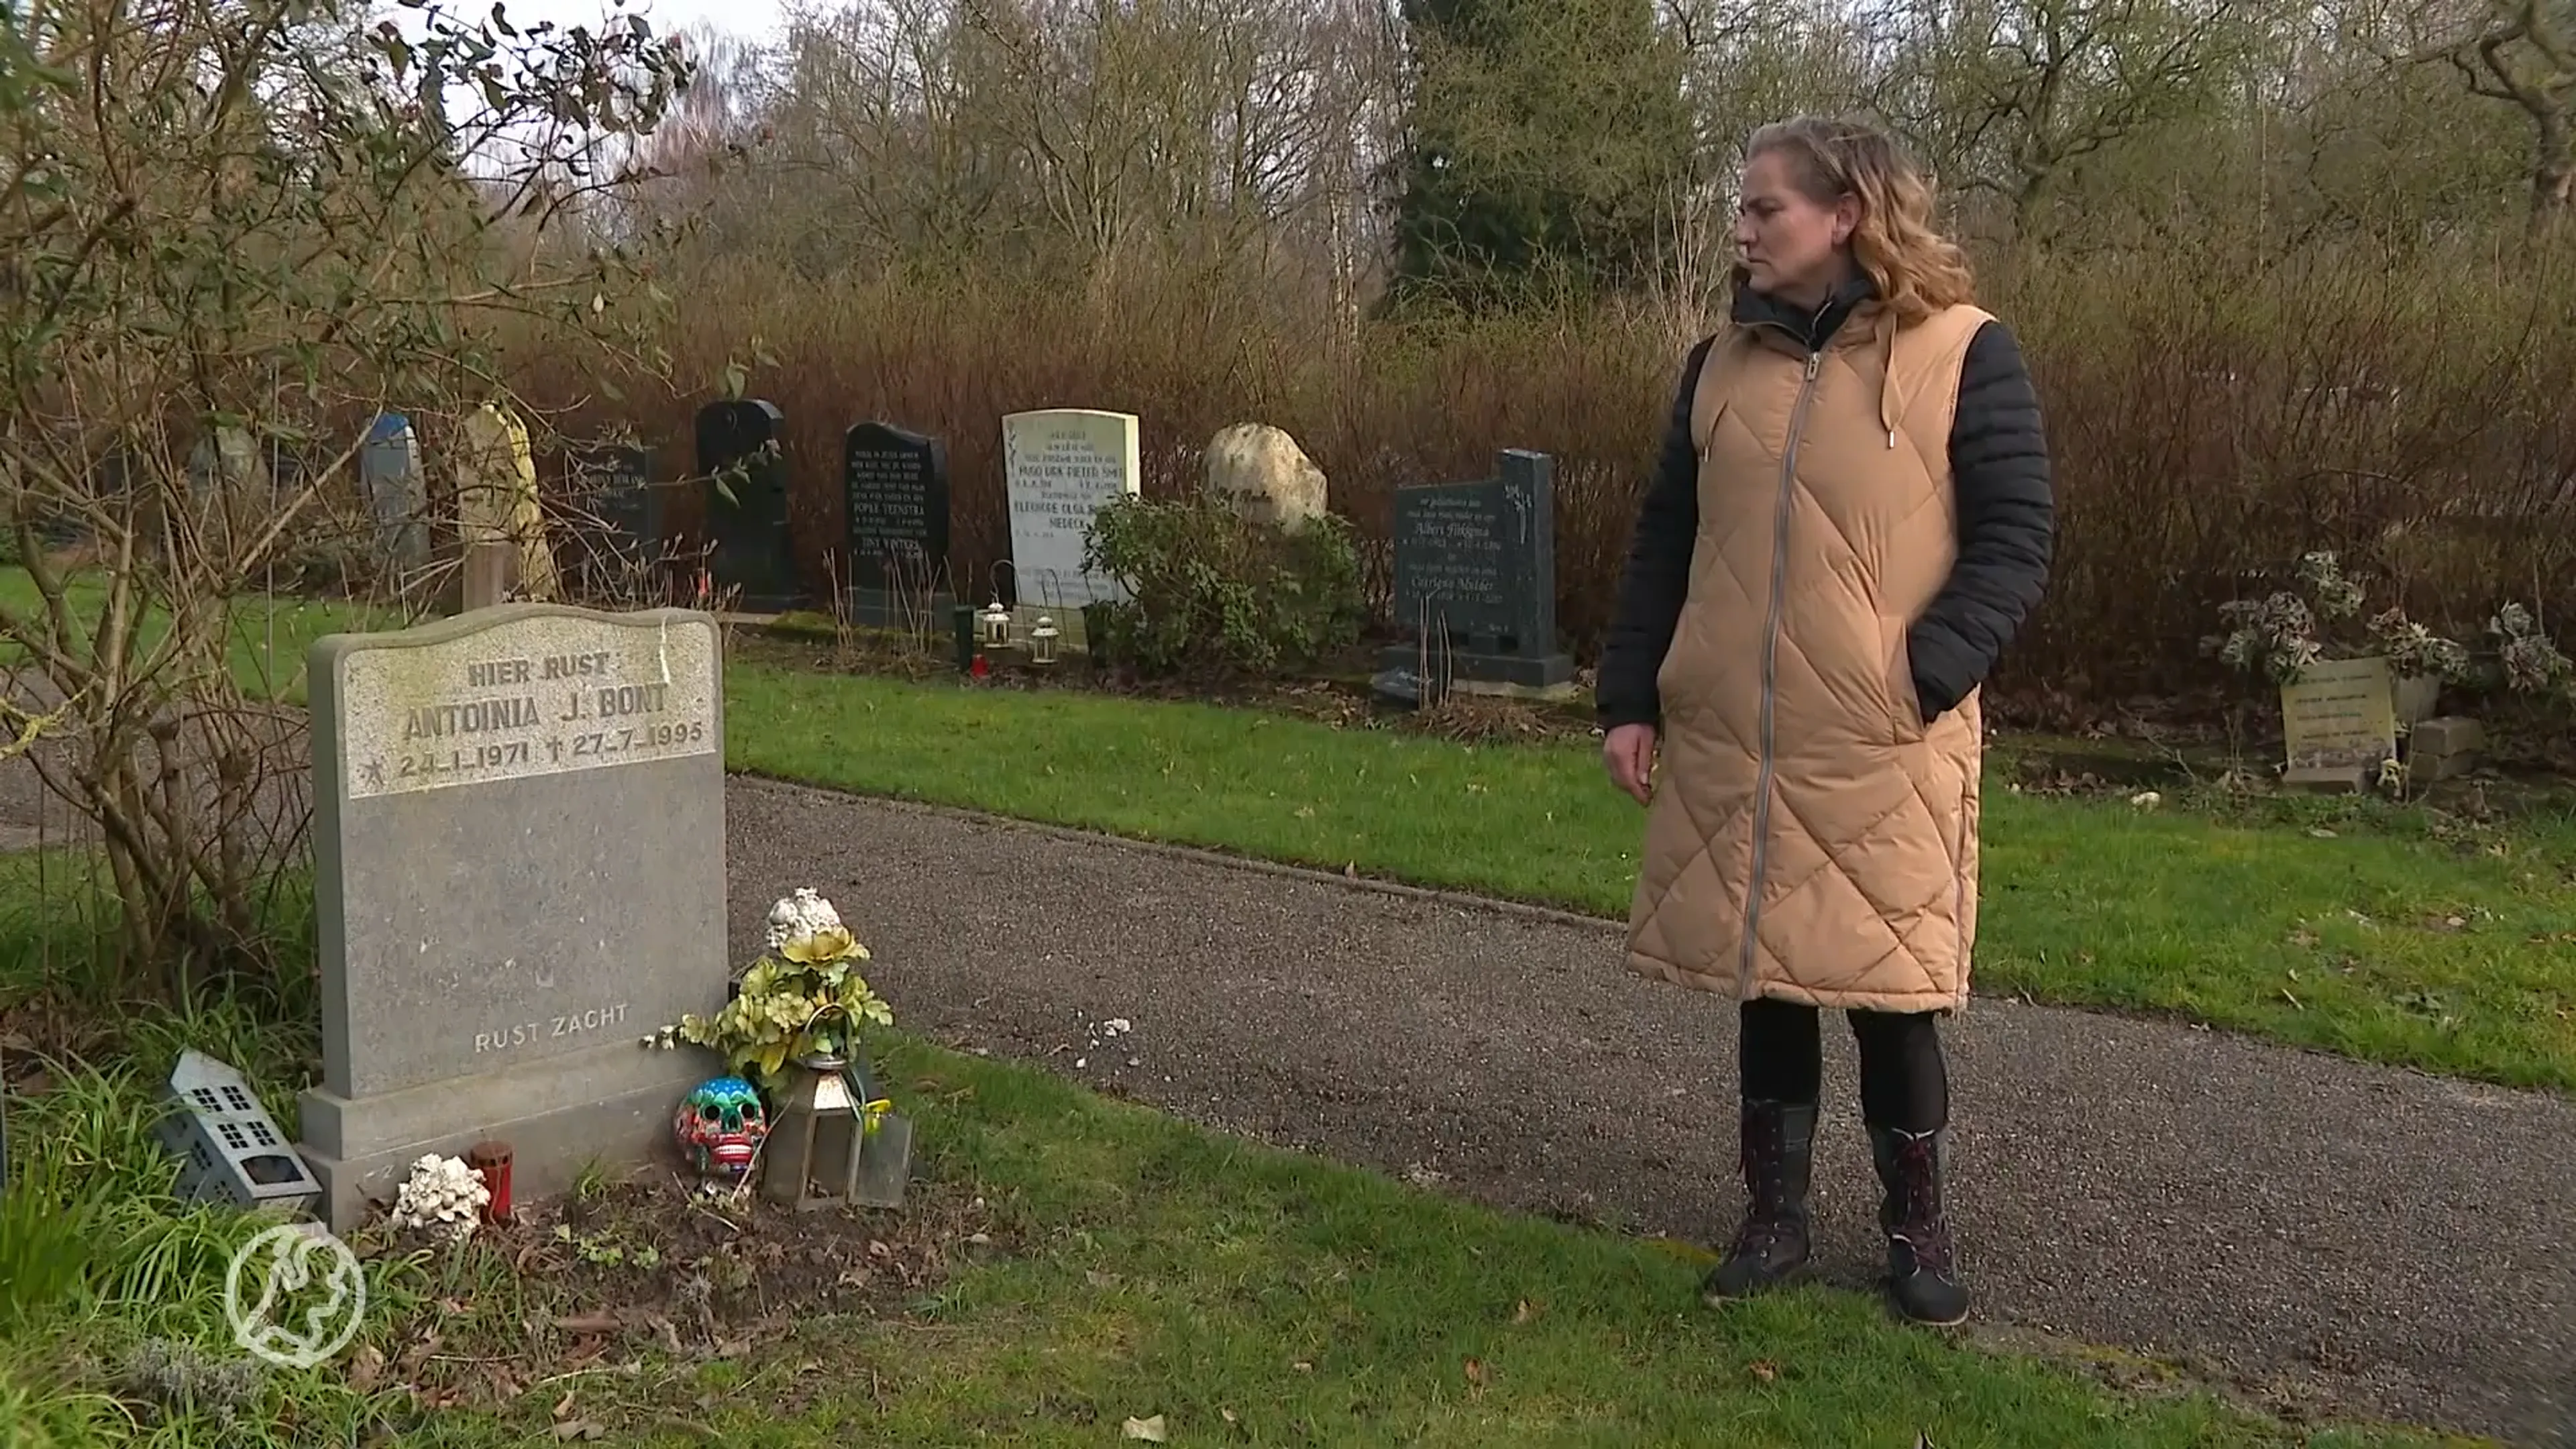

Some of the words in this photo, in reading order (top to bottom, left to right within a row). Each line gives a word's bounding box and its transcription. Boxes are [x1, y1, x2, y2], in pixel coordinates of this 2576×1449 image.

[469, 659, 530, 687] HIER
[403, 695, 541, 740] ANTOINIA
[559, 692, 586, 722] J.
[598, 683, 669, 718] BONT
[474, 1022, 539, 1053] RUST
[551, 1004, 627, 1037] ZACHT
